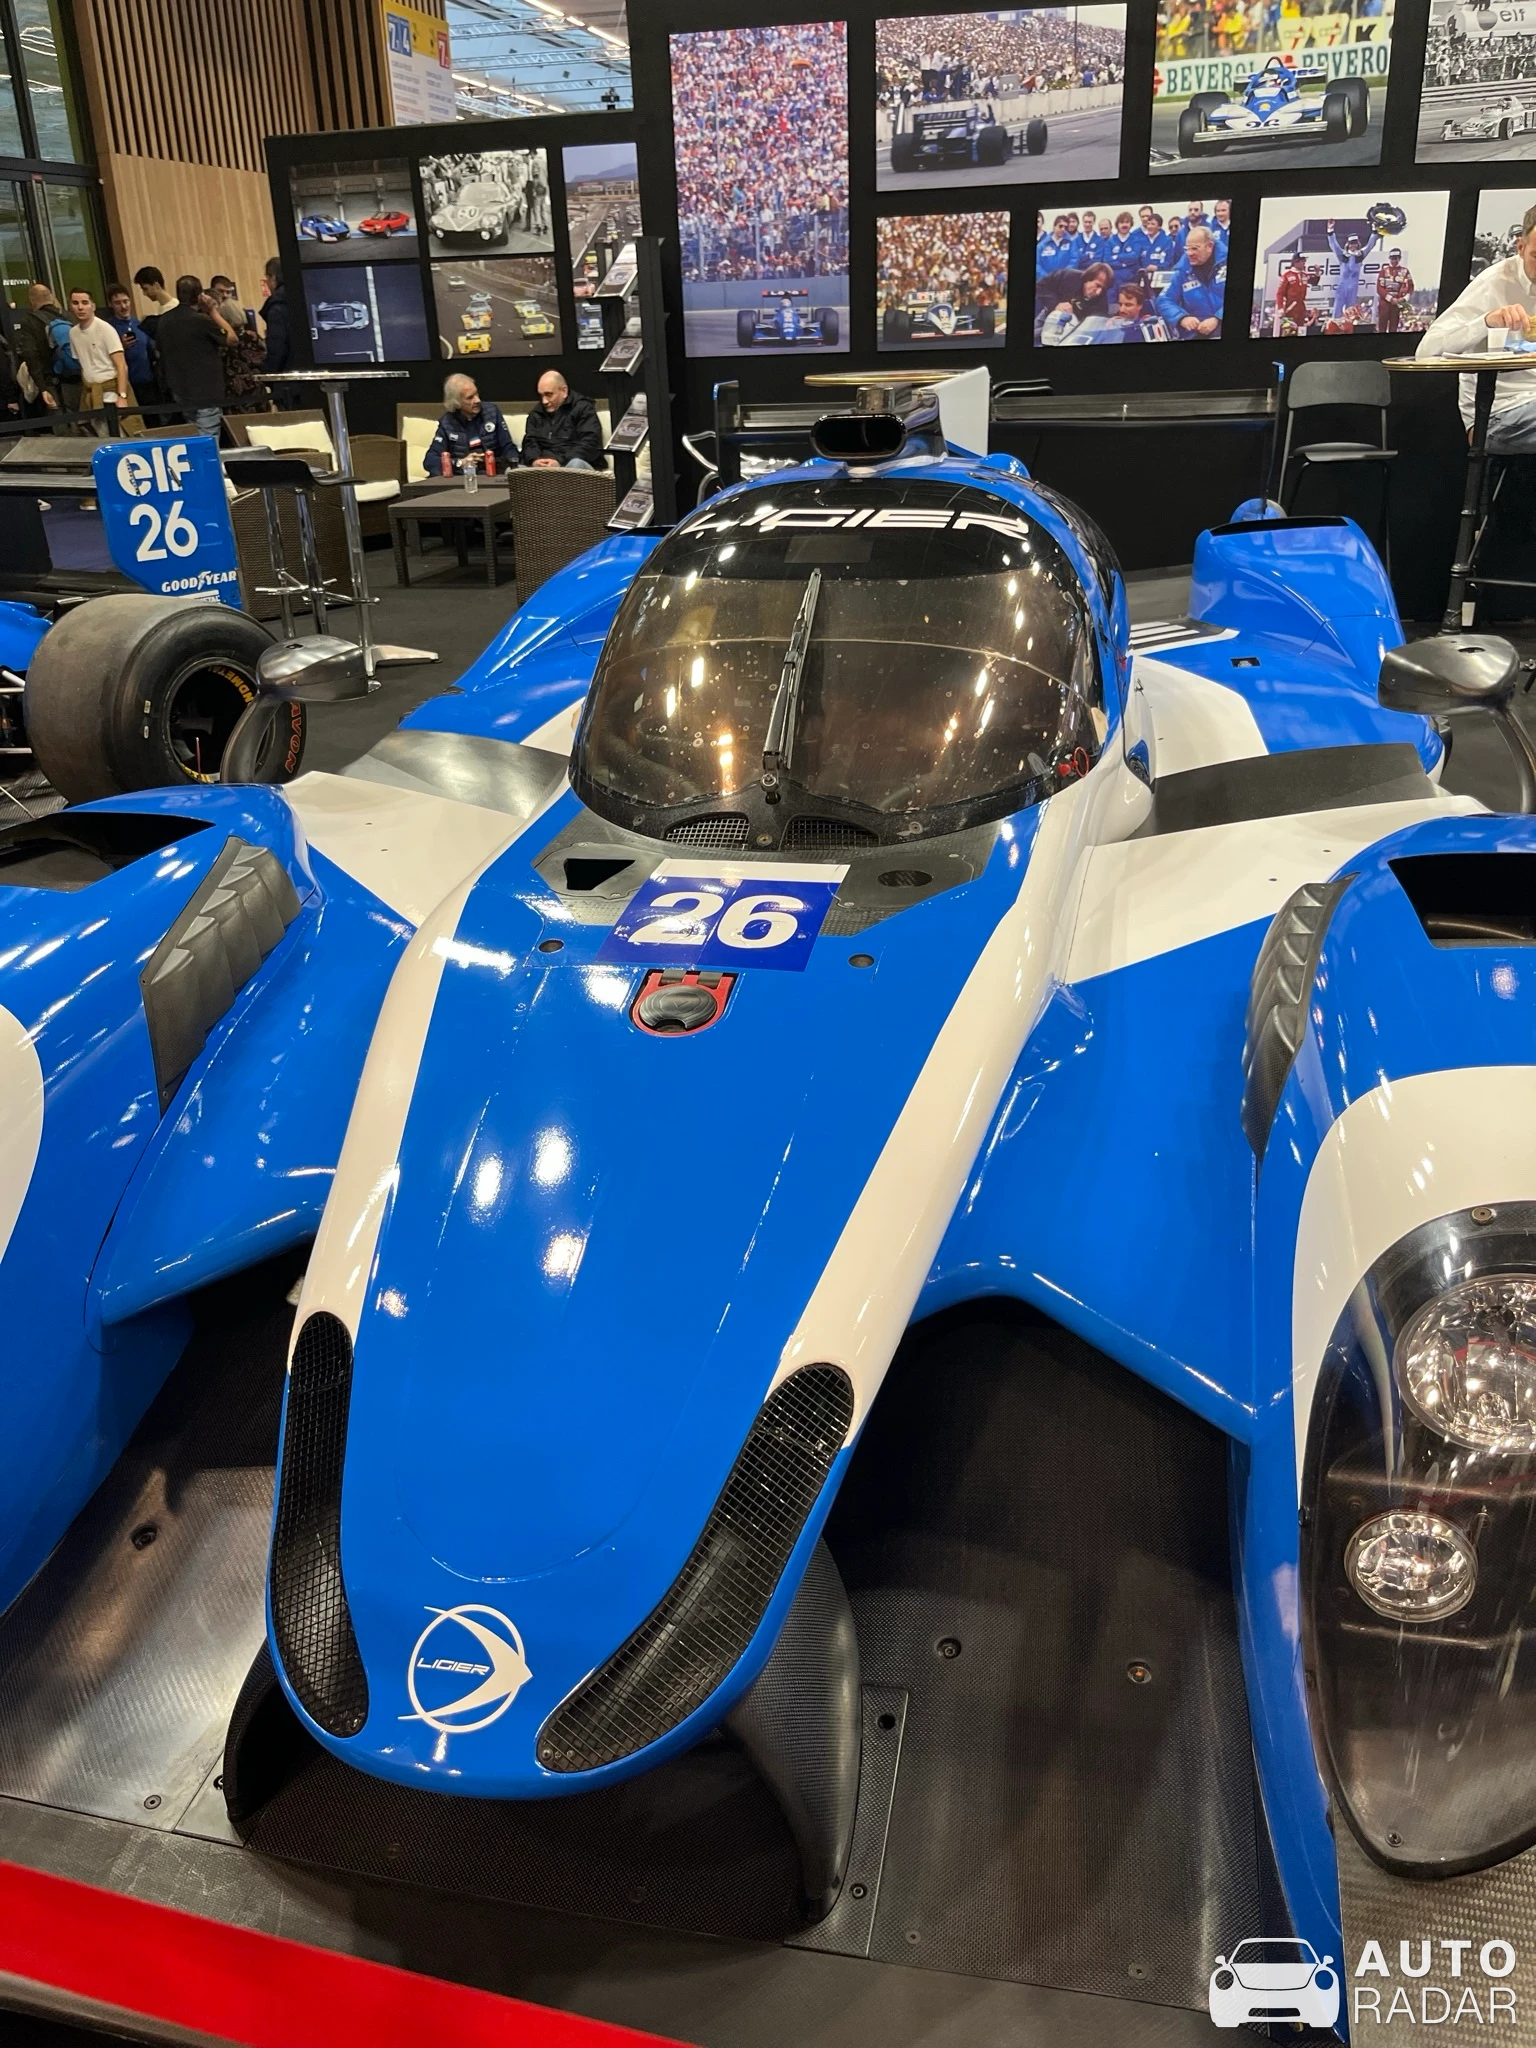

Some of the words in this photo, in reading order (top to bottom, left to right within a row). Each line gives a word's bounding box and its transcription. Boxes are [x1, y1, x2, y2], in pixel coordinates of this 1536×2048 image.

[1500, 8, 1525, 22] elf
[117, 444, 191, 497] elf
[130, 501, 198, 562] 26
[680, 508, 1030, 541] LIGIER
[285, 701, 302, 773] AVON
[628, 892, 804, 949] 26
[417, 1657, 490, 1676] LIGIER
